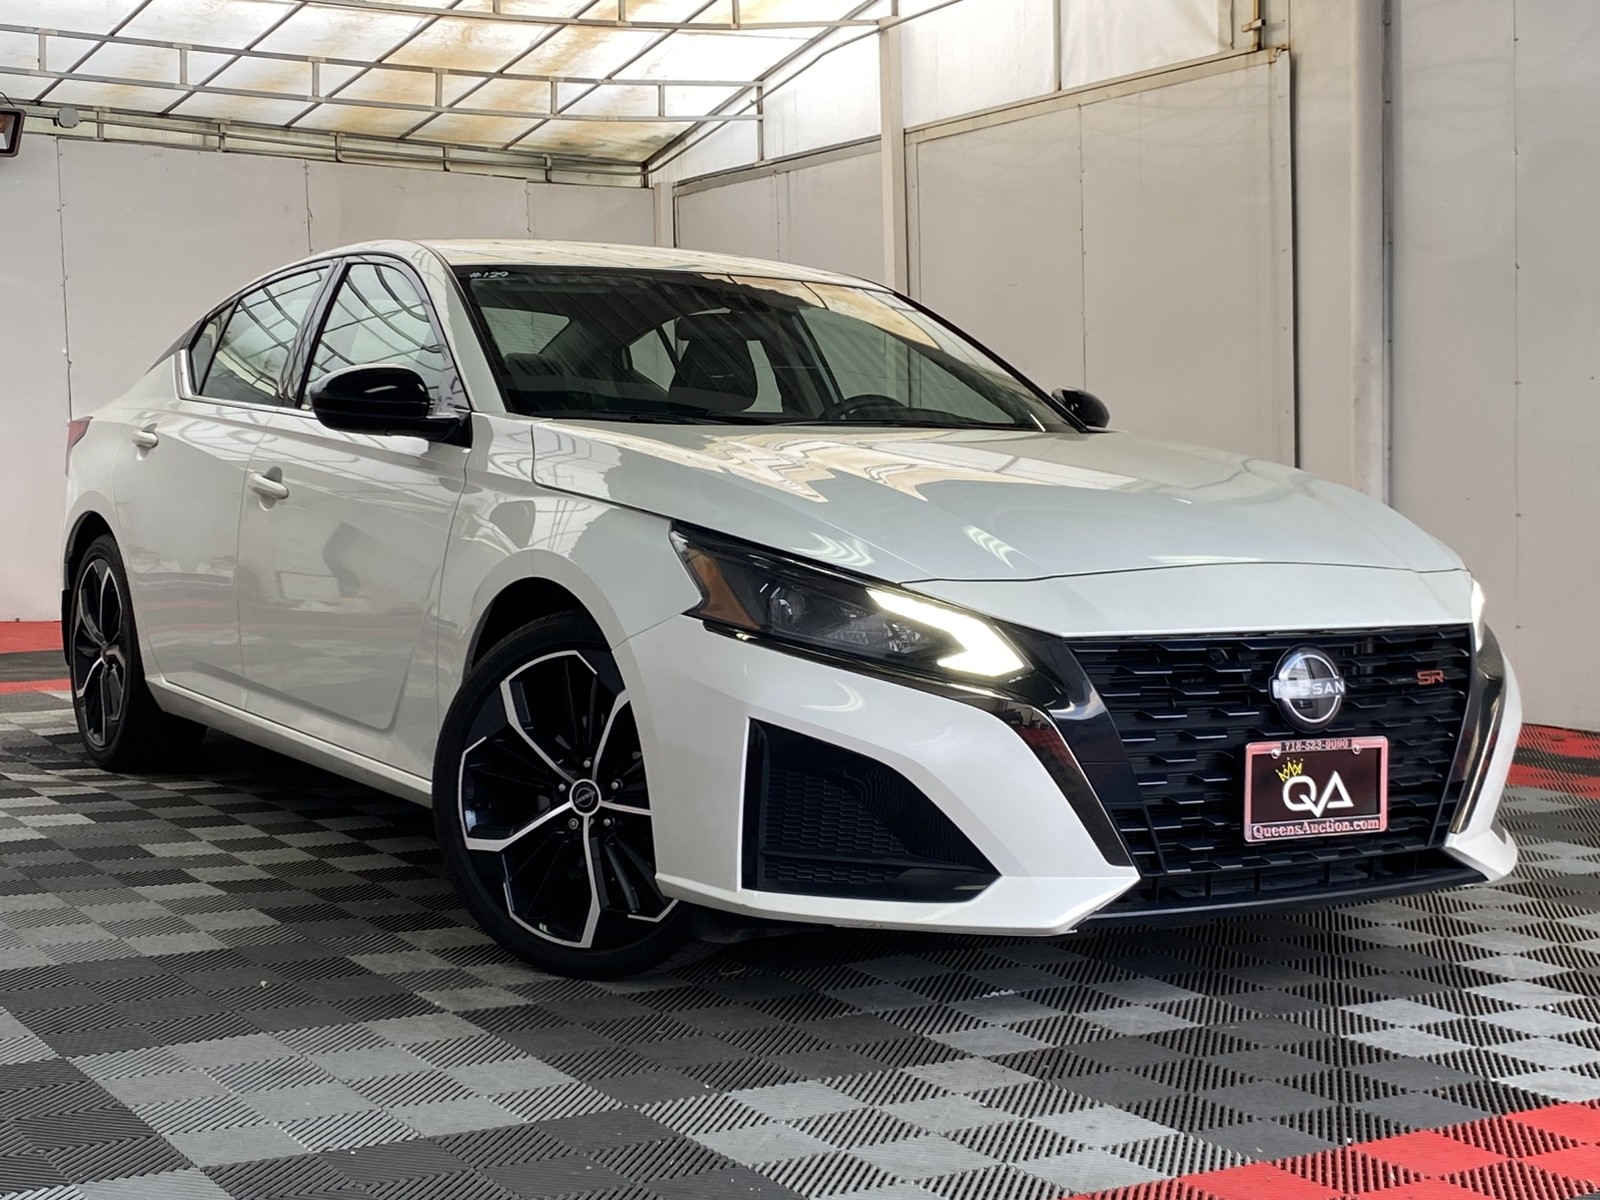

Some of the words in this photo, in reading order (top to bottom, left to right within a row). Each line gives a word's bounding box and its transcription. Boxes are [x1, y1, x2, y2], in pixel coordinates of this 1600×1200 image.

[1417, 670, 1444, 685] SR
[1282, 771, 1354, 817] QA
[1252, 819, 1379, 838] QueensAuction.com
